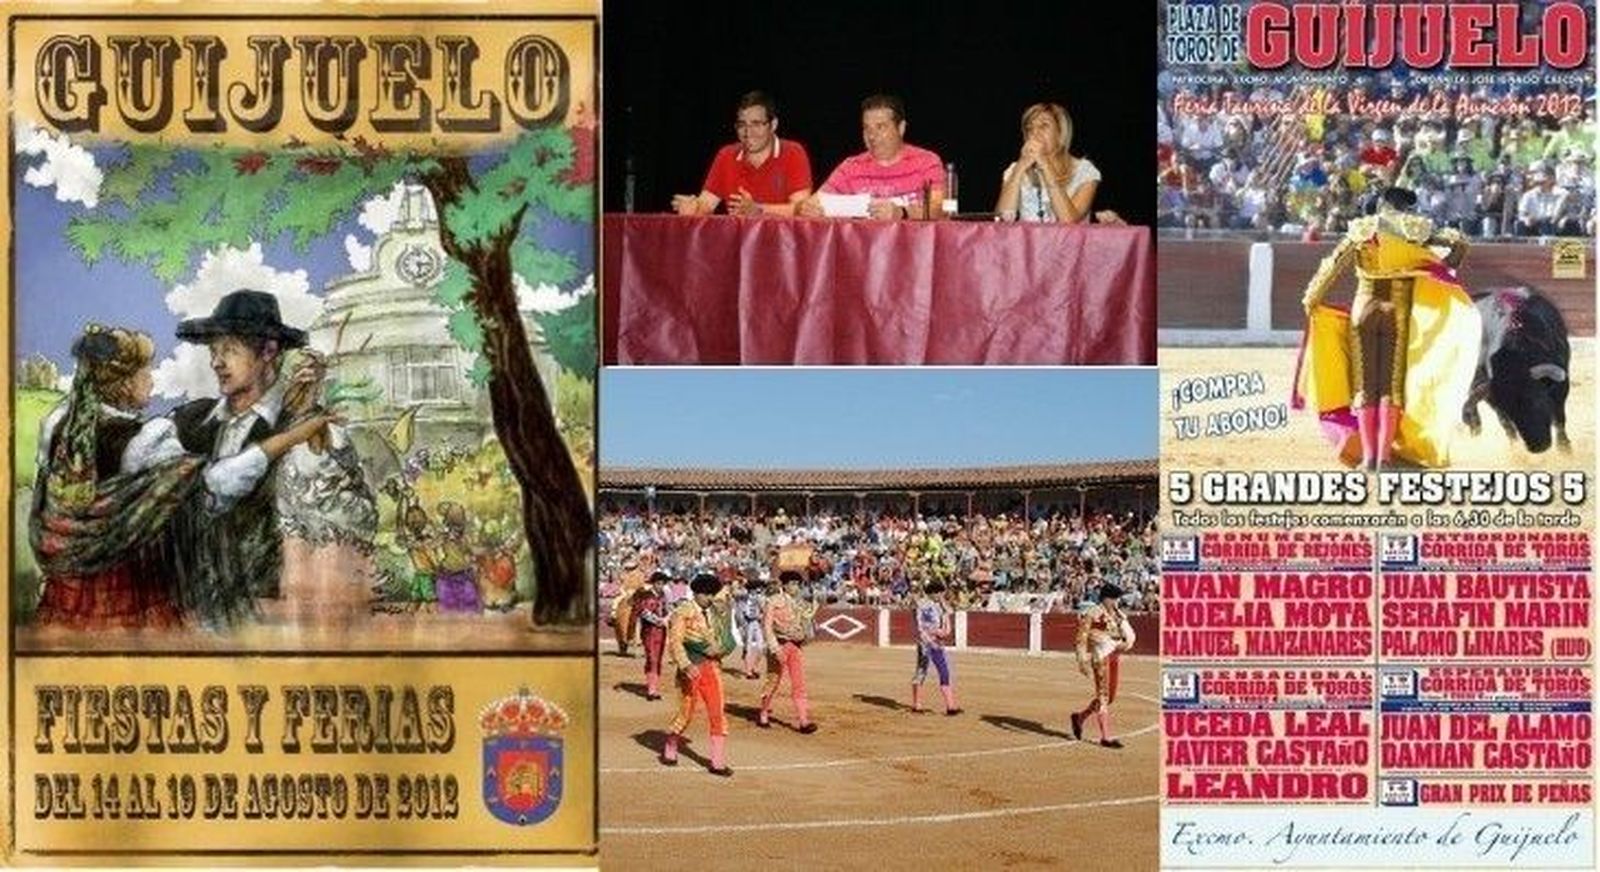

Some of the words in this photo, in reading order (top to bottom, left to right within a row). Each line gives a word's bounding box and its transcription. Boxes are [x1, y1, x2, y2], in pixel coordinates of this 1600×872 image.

[1167, 5, 1216, 33] PLAZA
[1220, 5, 1241, 33] DE
[1246, 3, 1588, 69] GUIJUELO
[1166, 35, 1217, 64] TOROS
[1220, 35, 1240, 64] DE
[35, 34, 571, 133] GUIJUELO
[1347, 90, 1401, 120] Virgen
[1537, 93, 1581, 117] 2012
[1172, 371, 1266, 412] ¡COMPRA
[1174, 416, 1201, 440] TU
[1205, 404, 1288, 437] ABONO!
[1169, 470, 1193, 505] 5
[1202, 470, 1369, 505] GRANDES
[1379, 471, 1553, 504] FESTEJOS
[1562, 471, 1586, 504] 5
[1173, 509, 1219, 528] Todos
[1221, 509, 1246, 528] los
[1249, 509, 1310, 530] festejos
[1410, 513, 1423, 528] a
[1425, 509, 1450, 528] las
[1493, 509, 1515, 528] de
[1516, 509, 1535, 528] la
[1536, 509, 1582, 528] tarde
[1203, 532, 1370, 542] MONUMENTAL
[1201, 543, 1271, 559] CORRIDA
[1277, 543, 1297, 559] DE
[1303, 543, 1372, 559] REJONES
[1420, 543, 1497, 559] CORRIDA
[1503, 543, 1526, 559] DE
[1531, 543, 1591, 559] TOROS
[1162, 574, 1242, 599] IVAN
[1254, 574, 1373, 599] MAGRO
[1381, 574, 1446, 599] JUAN
[1456, 574, 1591, 599] BAUTISTA
[1164, 602, 1275, 628] NOELIA
[1284, 602, 1372, 628] MOTA
[1382, 602, 1495, 628] SERAFIN
[1505, 602, 1589, 628] MARIN
[1162, 630, 1239, 656] MANUEL
[1245, 630, 1372, 656] MANZANARES
[1381, 630, 1458, 656] PALOMO
[1463, 630, 1544, 656] LINARES
[1550, 637, 1592, 661] (HIJO)
[1202, 671, 1373, 680] SENSACIONAL
[1202, 681, 1278, 695] CORRIDA
[1284, 681, 1308, 695] DE
[1312, 681, 1373, 695] TOROS
[1420, 677, 1497, 692] CORRIDA
[1503, 677, 1526, 692] DE
[1531, 677, 1591, 692] TOROS
[34, 684, 229, 754] FIESTAS
[237, 684, 269, 754] Y
[281, 684, 456, 754] FERIAS
[1164, 711, 1274, 737] UCEDA
[1284, 711, 1370, 737] LEAL
[1381, 714, 1441, 741] JUAN
[1449, 714, 1498, 741] DEL
[1505, 714, 1591, 741] ALAMO
[1165, 739, 1249, 766] JAVIER
[1256, 739, 1369, 766] CASTAÑO
[1381, 741, 1475, 769] DAMIAN
[1483, 741, 1591, 769] CASTAÑO
[34, 773, 86, 820] DEL
[92, 773, 120, 820] 14
[126, 773, 161, 820] AL
[166, 773, 196, 820] 19
[203, 773, 238, 820] DE
[243, 773, 348, 820] AGOSTO
[354, 773, 390, 820] DE
[397, 773, 459, 820] 2012
[1166, 773, 1369, 799] LEANDRO
[1420, 783, 1463, 803] GRAN
[1469, 783, 1507, 803] PRIX
[1512, 783, 1533, 803] DE
[1538, 780, 1591, 803] PEÑAS
[1172, 821, 1254, 855] Excmo.
[1265, 821, 1434, 864] Ayuntamiento
[1436, 812, 1471, 845] de
[1475, 812, 1581, 861] Guijuelo
